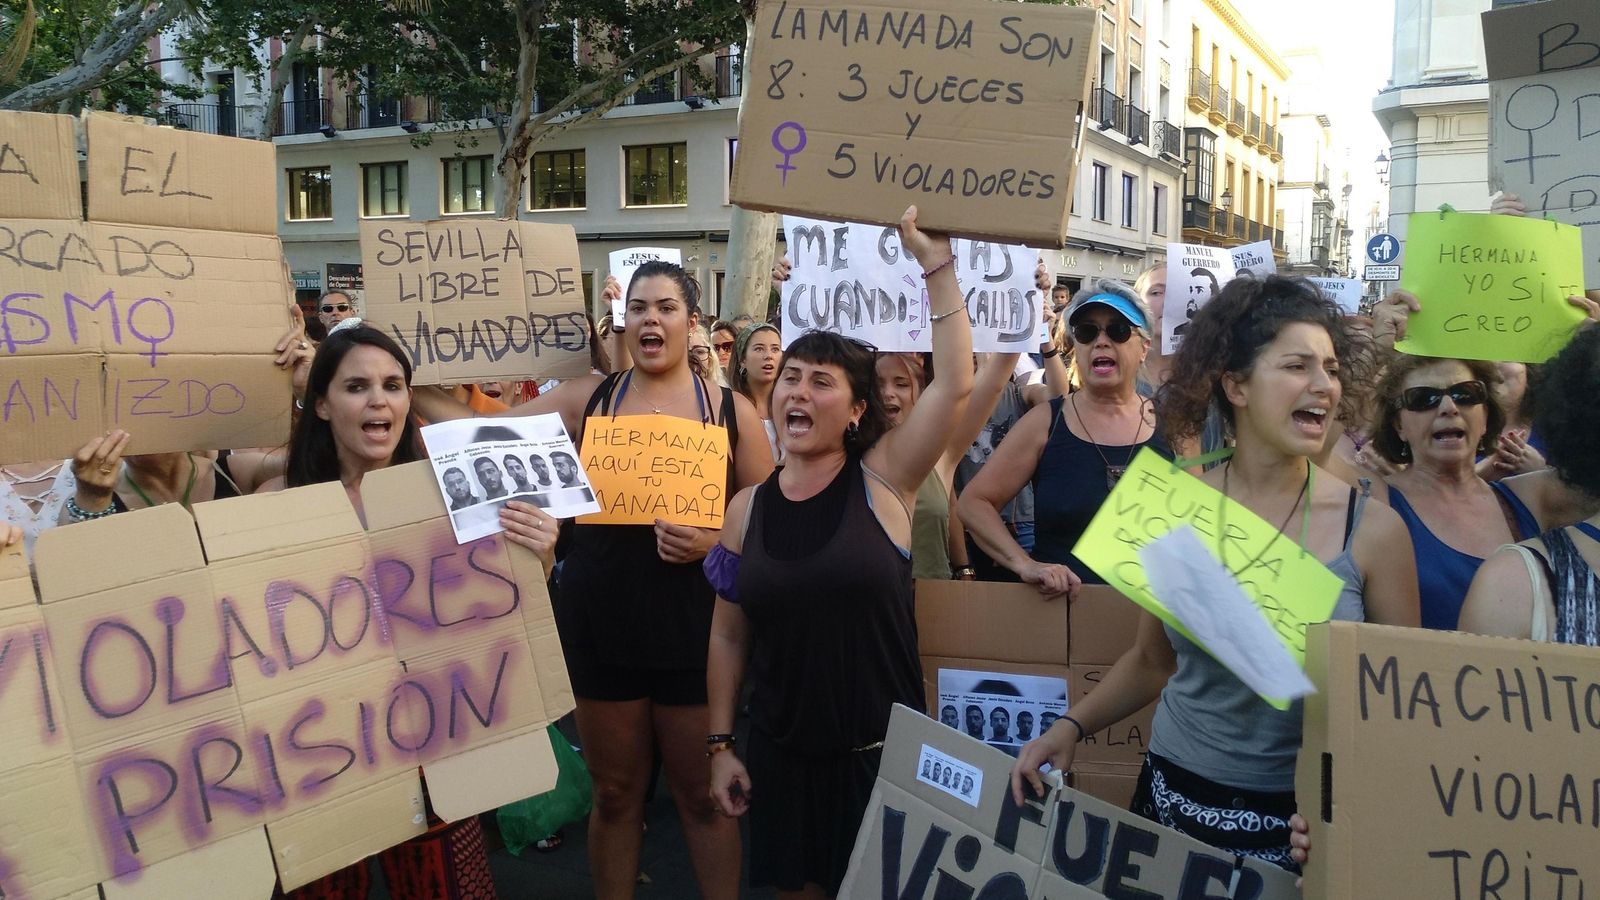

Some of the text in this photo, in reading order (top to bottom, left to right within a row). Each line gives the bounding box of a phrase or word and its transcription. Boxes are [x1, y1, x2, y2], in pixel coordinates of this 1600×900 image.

[1000, 16, 1074, 67] SON
[838, 63, 867, 102] 3
[888, 70, 1024, 105] JUECES
[120, 146, 212, 199] EL
[827, 143, 857, 179] 5
[377, 228, 523, 267] SEVILLA
[629, 252, 660, 260] JESUS
[792, 224, 849, 272] ME
[1186, 246, 1214, 257] MANUEL
[1439, 244, 1538, 264] HERMANA
[1182, 257, 1220, 269] GUERRERO
[399, 268, 576, 304] LIBRE DE
[1323, 281, 1345, 290] JESUS
[1463, 273, 1494, 294] YO
[1443, 314, 1532, 333] CREO
[392, 311, 587, 372] VIOLADORES
[638, 476, 662, 487] TU
